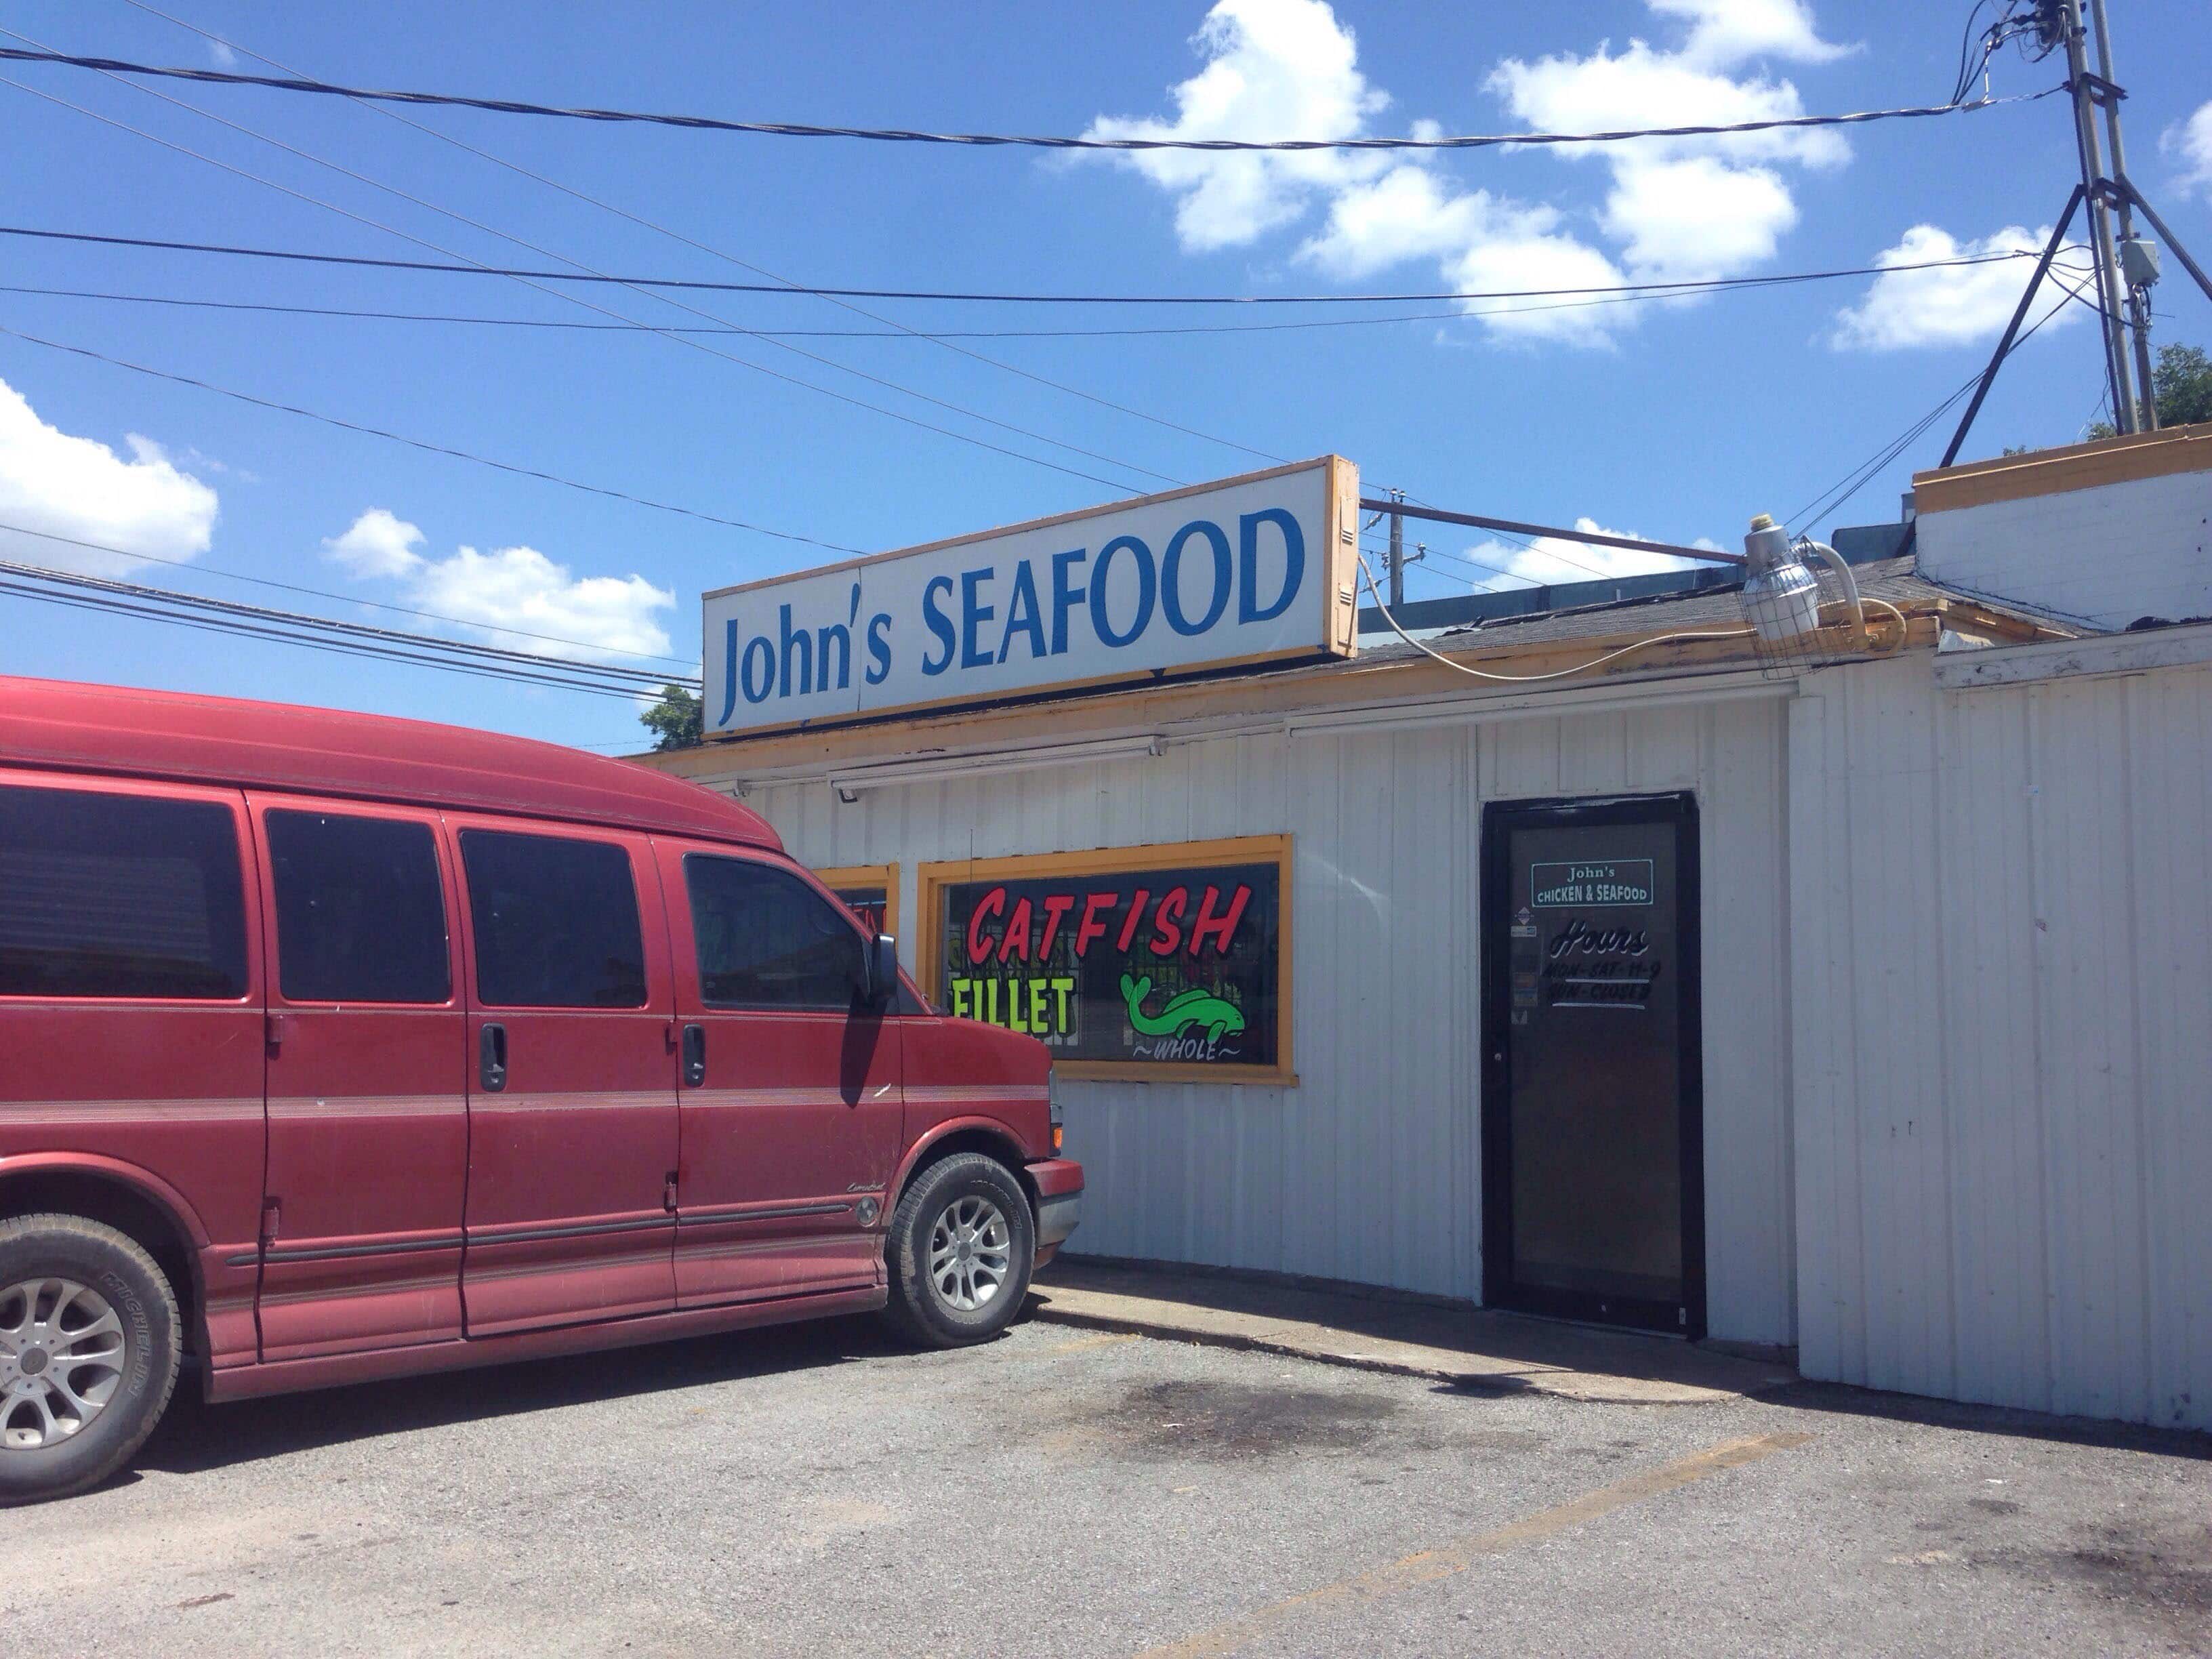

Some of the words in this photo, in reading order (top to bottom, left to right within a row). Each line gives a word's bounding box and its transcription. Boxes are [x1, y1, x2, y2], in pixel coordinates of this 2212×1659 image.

[718, 582, 892, 727] John's
[922, 507, 1305, 676] SEAFOOD
[1537, 884, 1582, 903] CHICKEN
[1586, 884, 1593, 902] &
[1597, 884, 1647, 902] SEAFOOD
[1567, 866, 1615, 883] John's
[967, 884, 1252, 965] CATFISH
[1550, 918, 1650, 959] Hours
[951, 977, 1074, 1035] FILLET
[100, 1270, 151, 1398] MICHELIN
